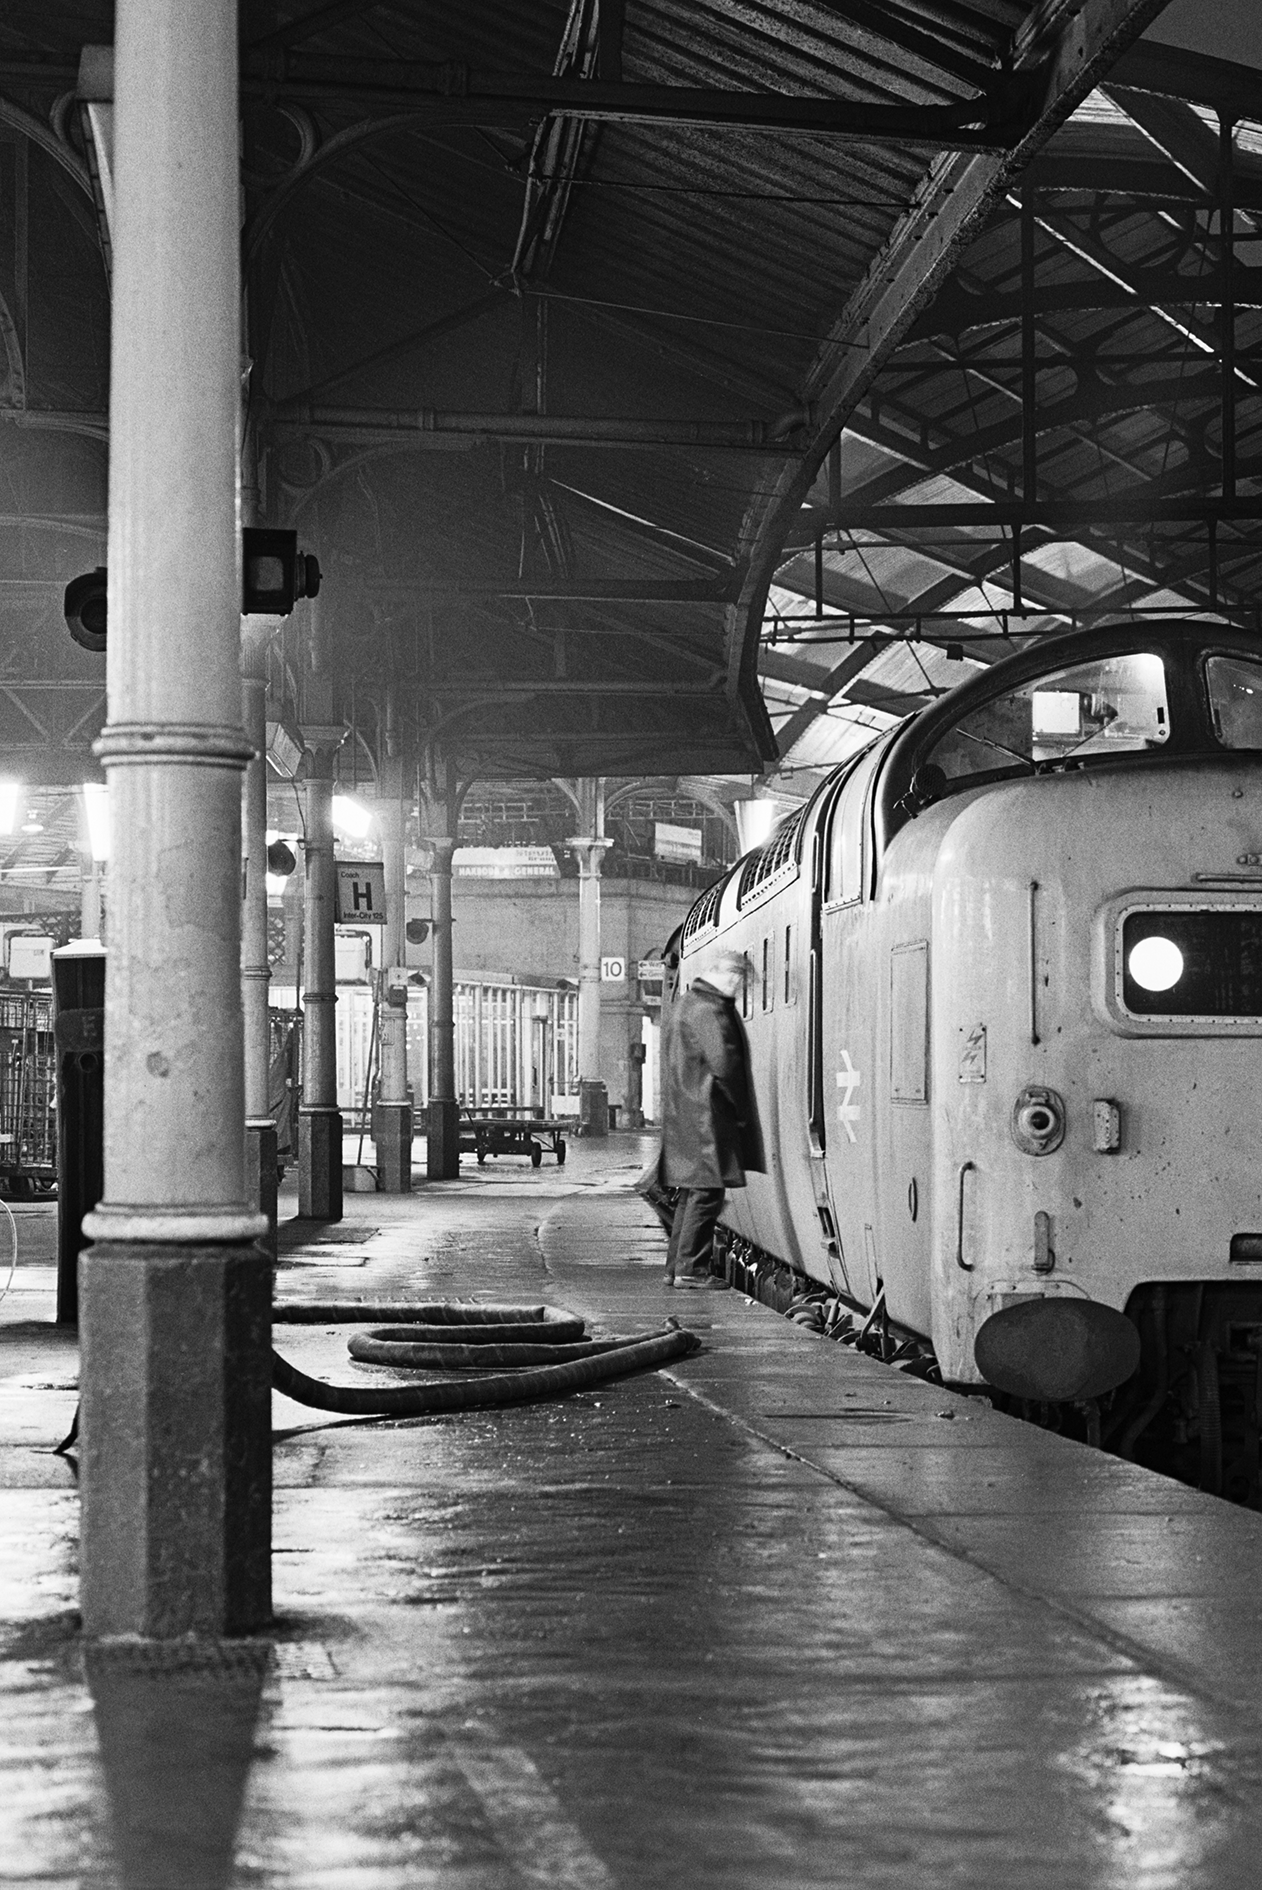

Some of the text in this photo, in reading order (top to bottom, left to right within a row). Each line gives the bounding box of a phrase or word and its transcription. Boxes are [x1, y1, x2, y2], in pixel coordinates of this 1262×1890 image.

[514, 866, 556, 876] GENERAL
[352, 882, 373, 911] H
[343, 911, 371, 920] Inter-City
[603, 961, 622, 977] 10
